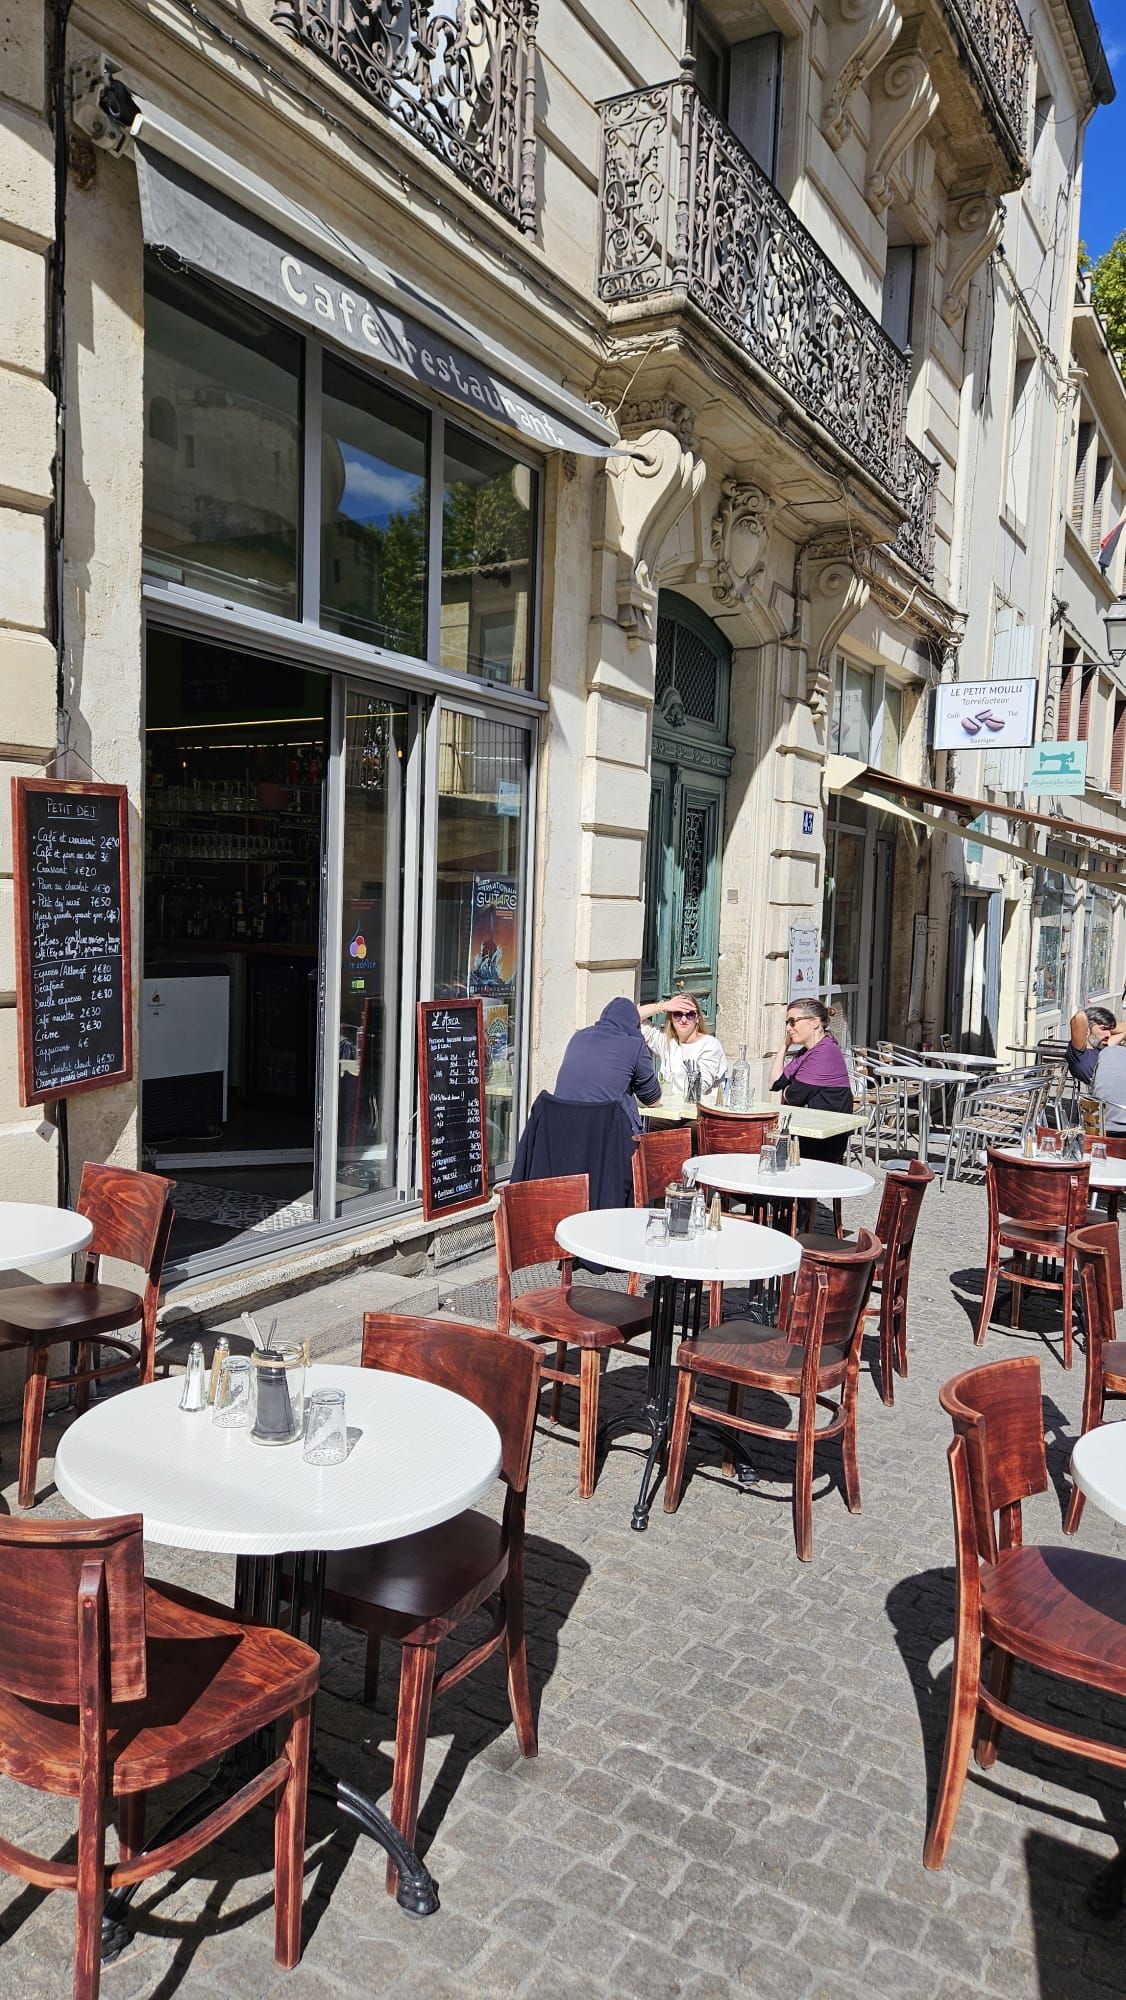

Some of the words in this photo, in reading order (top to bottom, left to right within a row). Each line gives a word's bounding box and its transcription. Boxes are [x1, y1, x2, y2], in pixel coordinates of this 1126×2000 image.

[280, 255, 381, 346] Café
[402, 335, 565, 447] restaurant
[950, 688, 961, 697] LE
[963, 687, 986, 696] PETIT
[989, 685, 1023, 695] MOULU
[961, 697, 1010, 706] Torréfacteur
[46, 798, 72, 815] PETIT
[37, 827, 57, 850] Café
[36, 844, 52, 864] Café
[37, 862, 68, 874] Croissant
[37, 876, 54, 890] Pain
[65, 879, 89, 892] chocolat
[37, 893, 53, 908] Petit
[477, 891, 517, 910] GUITARE
[80, 1020, 102, 1033] 3€30
